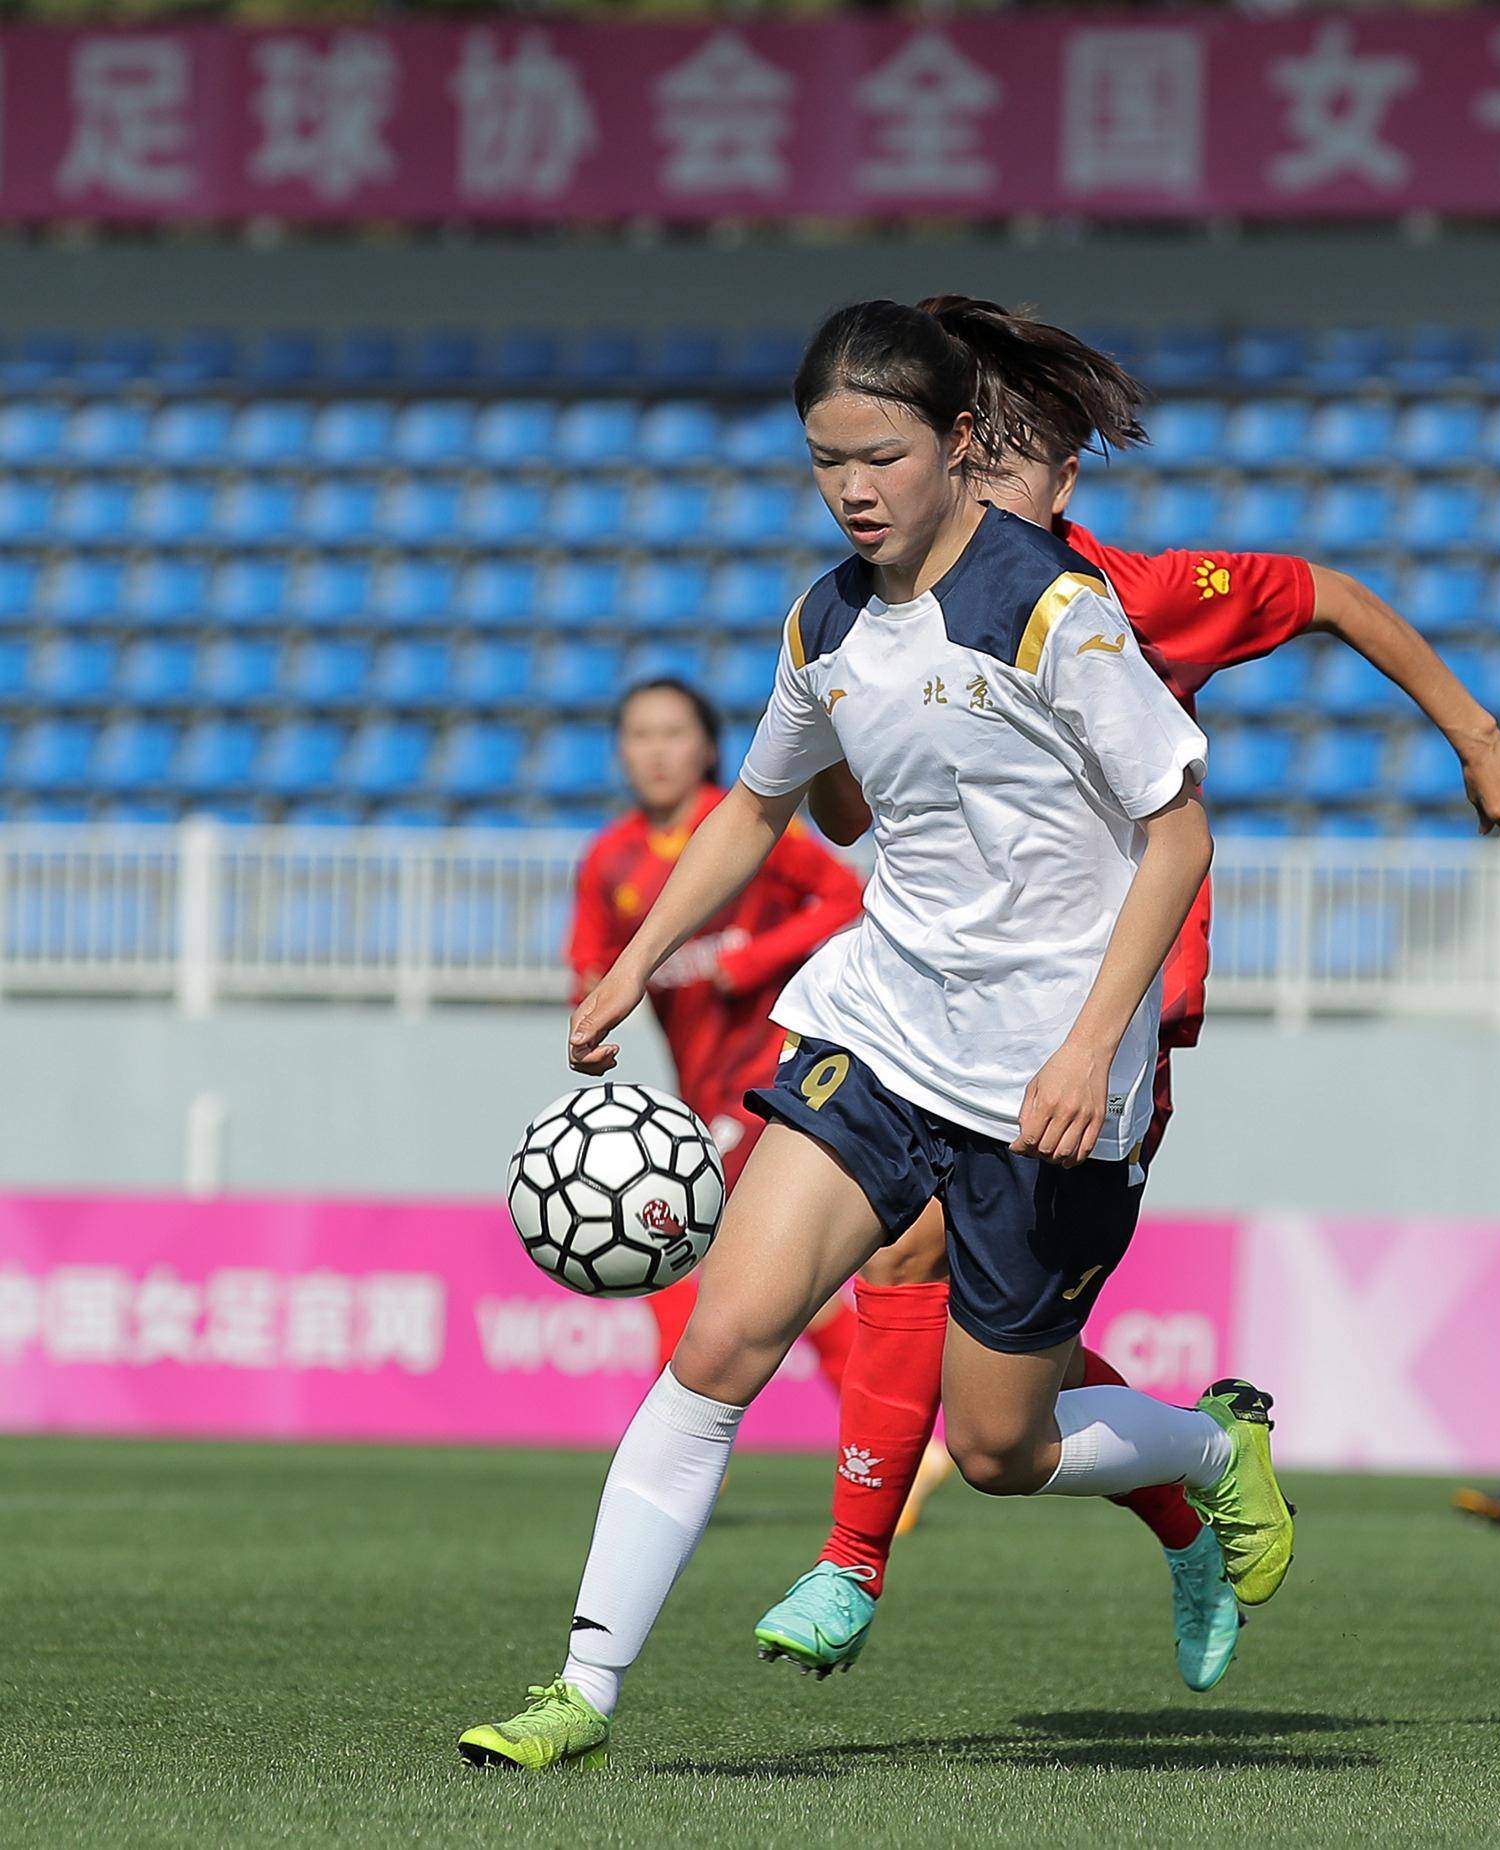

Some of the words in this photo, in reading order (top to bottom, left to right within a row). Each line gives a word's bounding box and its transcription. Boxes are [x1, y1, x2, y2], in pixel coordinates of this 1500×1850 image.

[922, 674, 994, 710] 北京
[801, 1053, 850, 1111] 9
[838, 1464, 883, 1488] KELME
